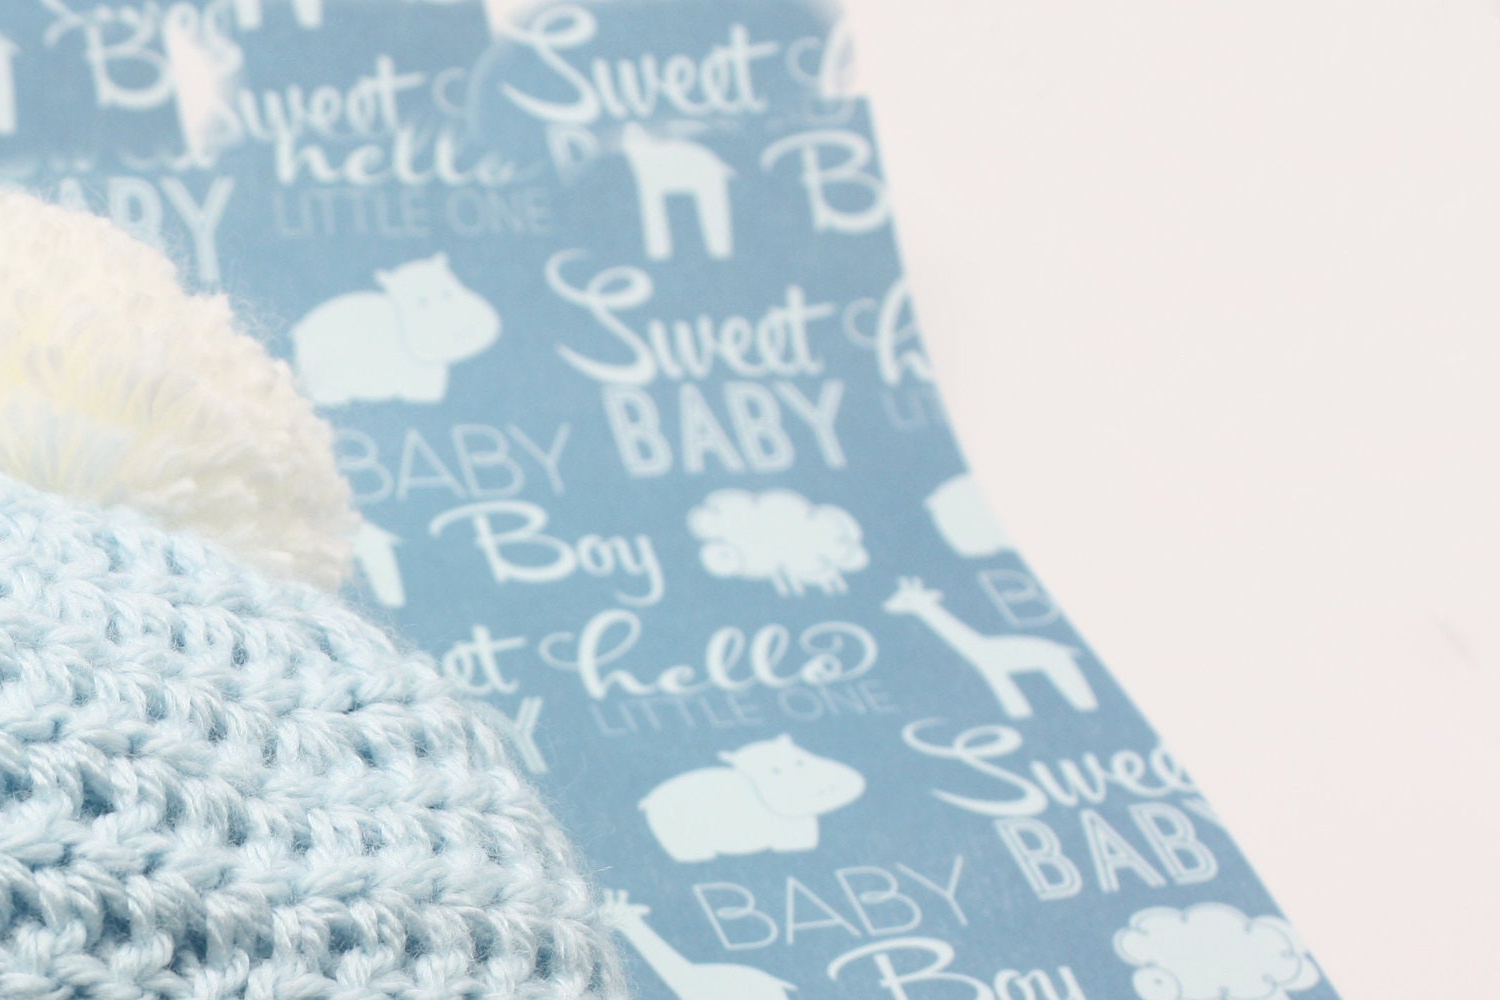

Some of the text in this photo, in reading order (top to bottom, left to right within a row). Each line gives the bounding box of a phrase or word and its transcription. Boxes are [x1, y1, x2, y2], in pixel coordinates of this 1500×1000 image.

[490, 0, 779, 125] Sweet
[543, 248, 838, 386] Sweet
[333, 421, 573, 502] BABY
[605, 378, 849, 477] BABY
[429, 499, 666, 608] Boy
[538, 607, 879, 700] hello
[901, 716, 1200, 817] Swee
[993, 797, 1222, 901] BAB
[692, 854, 969, 951] BABY
